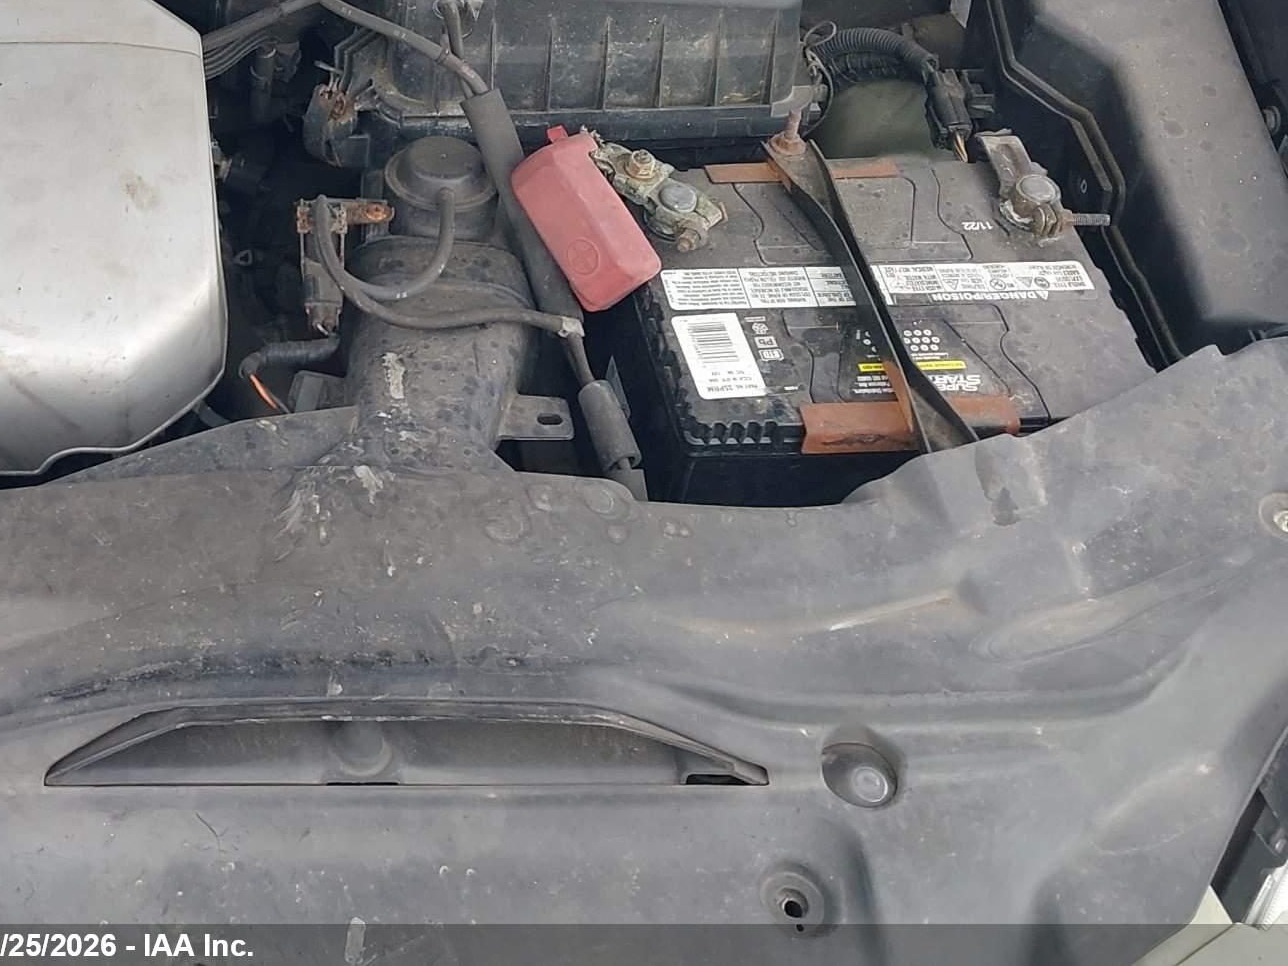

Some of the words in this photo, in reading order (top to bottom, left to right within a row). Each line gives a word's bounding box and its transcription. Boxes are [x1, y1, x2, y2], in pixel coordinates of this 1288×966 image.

[961, 221, 993, 231] 11/22
[931, 290, 1038, 301] DANGER/POISON
[938, 383, 978, 392] SUPE
